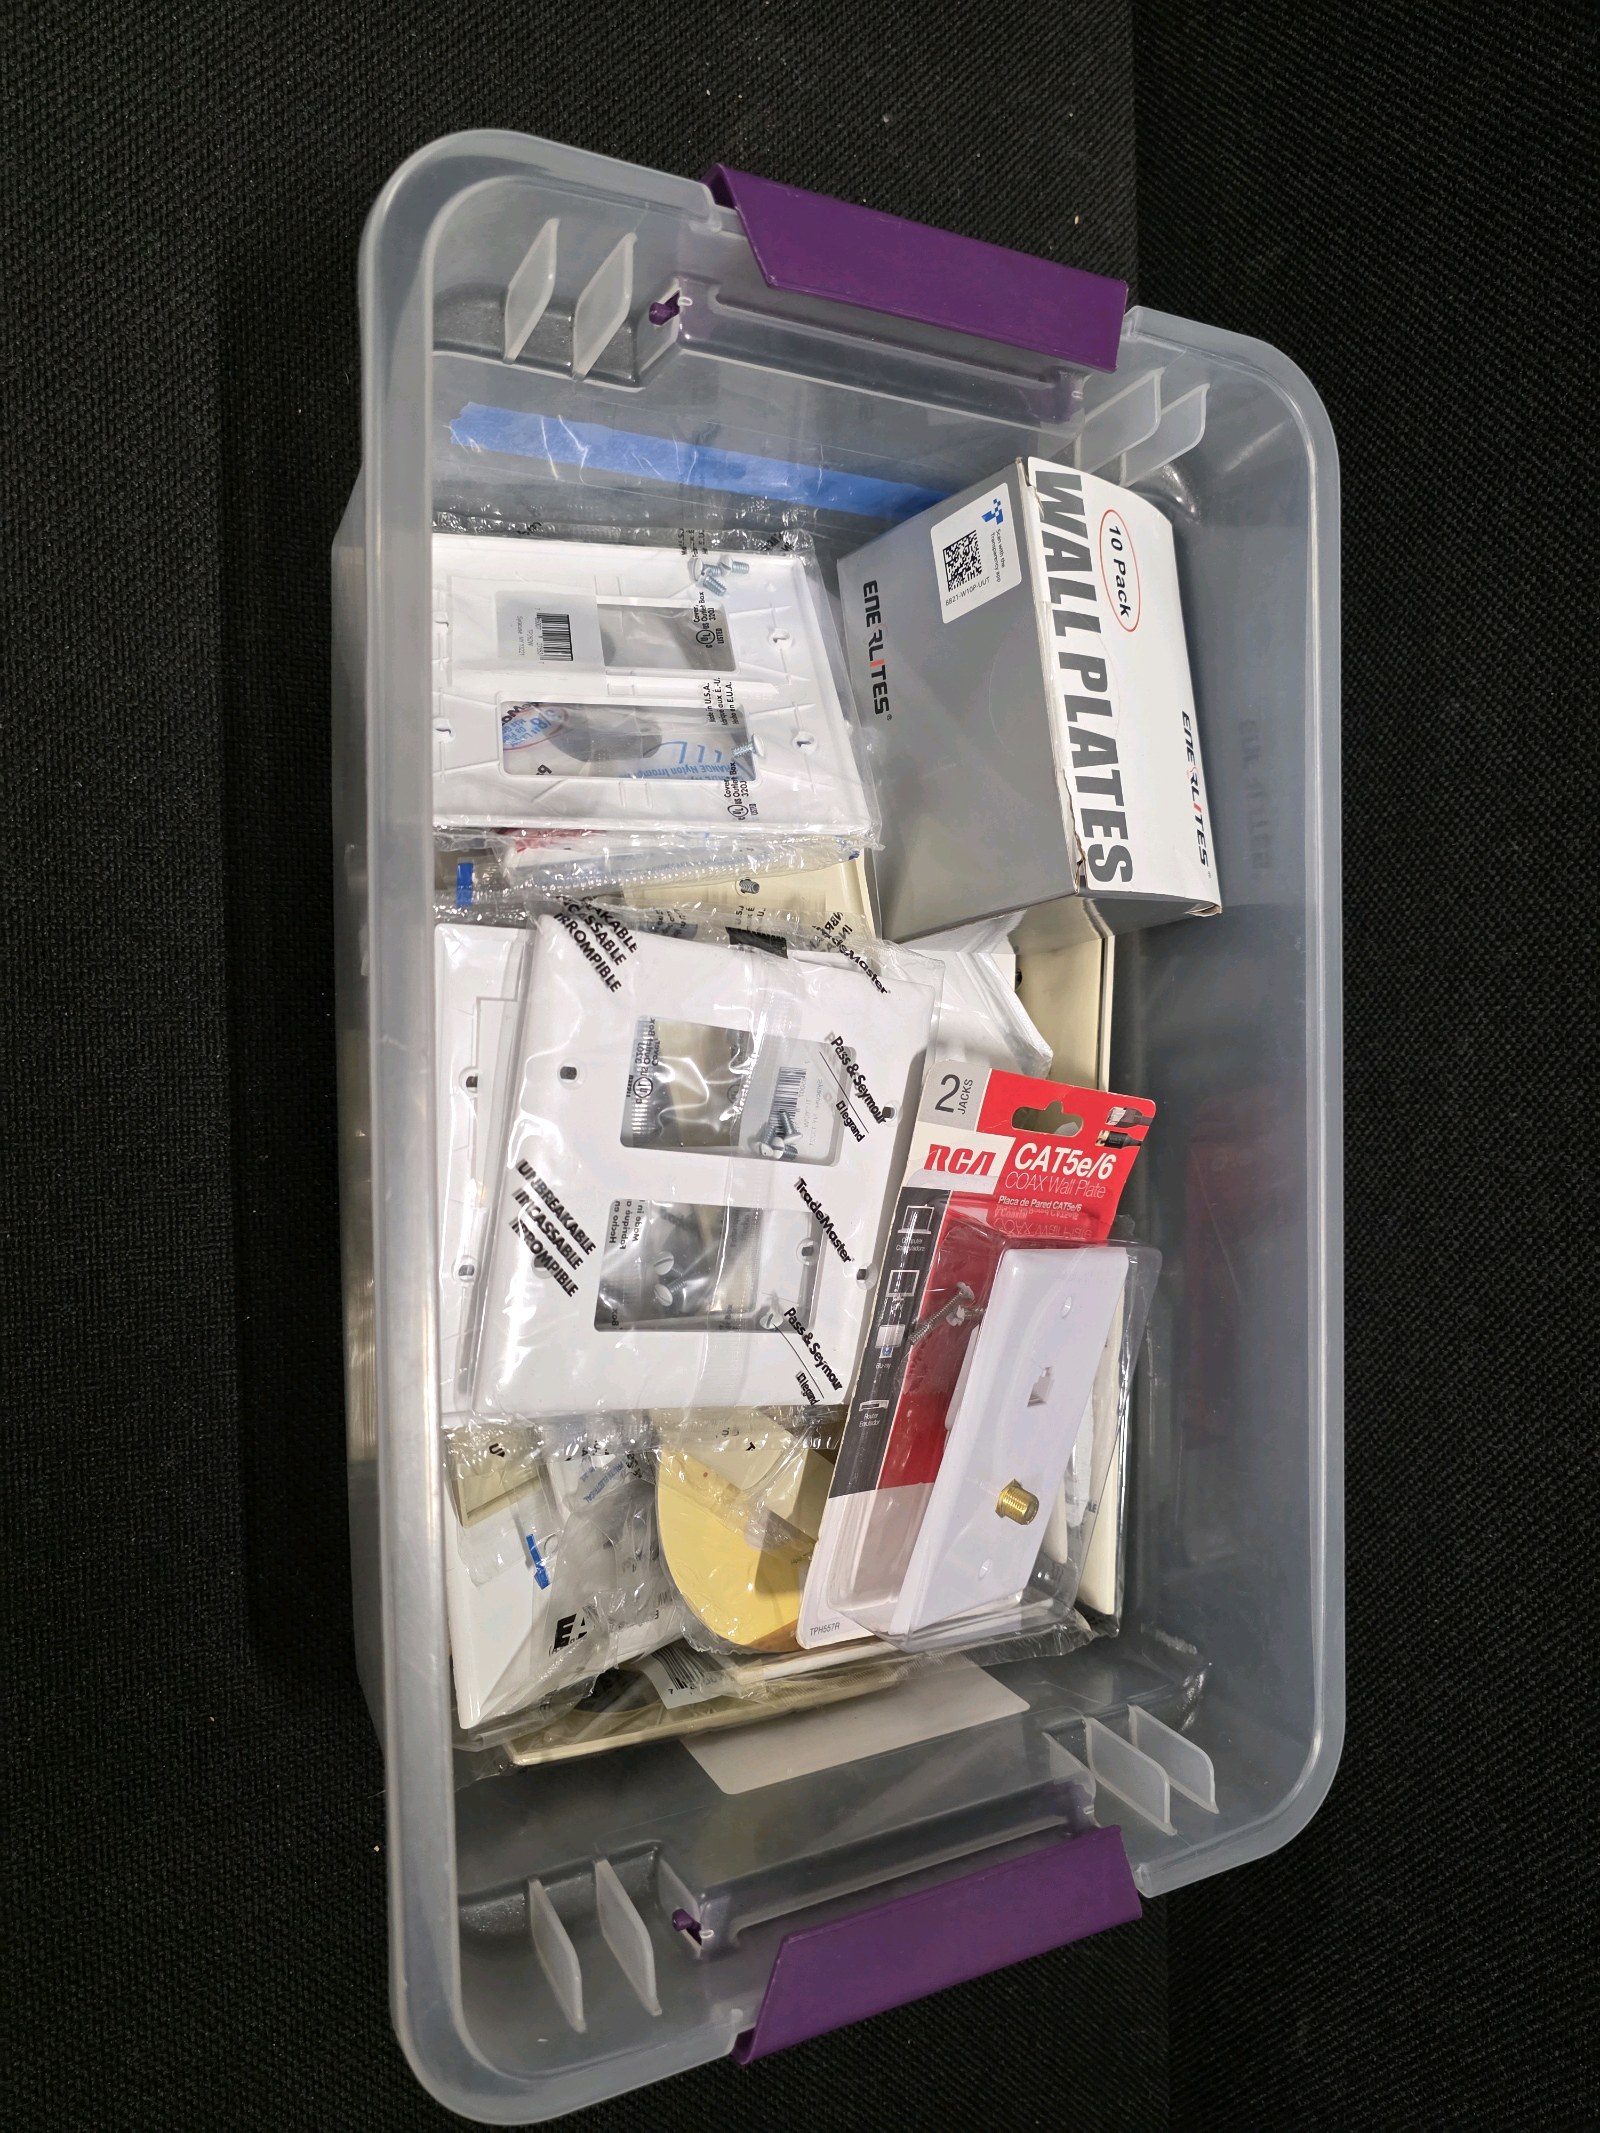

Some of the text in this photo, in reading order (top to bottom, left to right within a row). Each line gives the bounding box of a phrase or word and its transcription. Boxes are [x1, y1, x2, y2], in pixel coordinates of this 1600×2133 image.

[991, 531, 999, 571] Transparency
[1108, 524, 1131, 617] 10 Pack
[1036, 470, 1133, 883] WALL PLATES
[554, 912, 622, 992] IRROMPIBLE
[831, 1036, 886, 1124] Pass & Seymour
[935, 1073, 961, 1113] 2
[957, 1079, 974, 1115] JACKS
[923, 1144, 997, 1176] RCA
[1014, 1142, 1117, 1180] CAT5e/6
[998, 1195, 1082, 1212] Placa de Pared CAT5e/6
[1005, 1171, 1106, 1198] COAX Wall Plate
[795, 1177, 851, 1263] TradeMaster
[784, 1308, 843, 1391] Pass & Seymour
